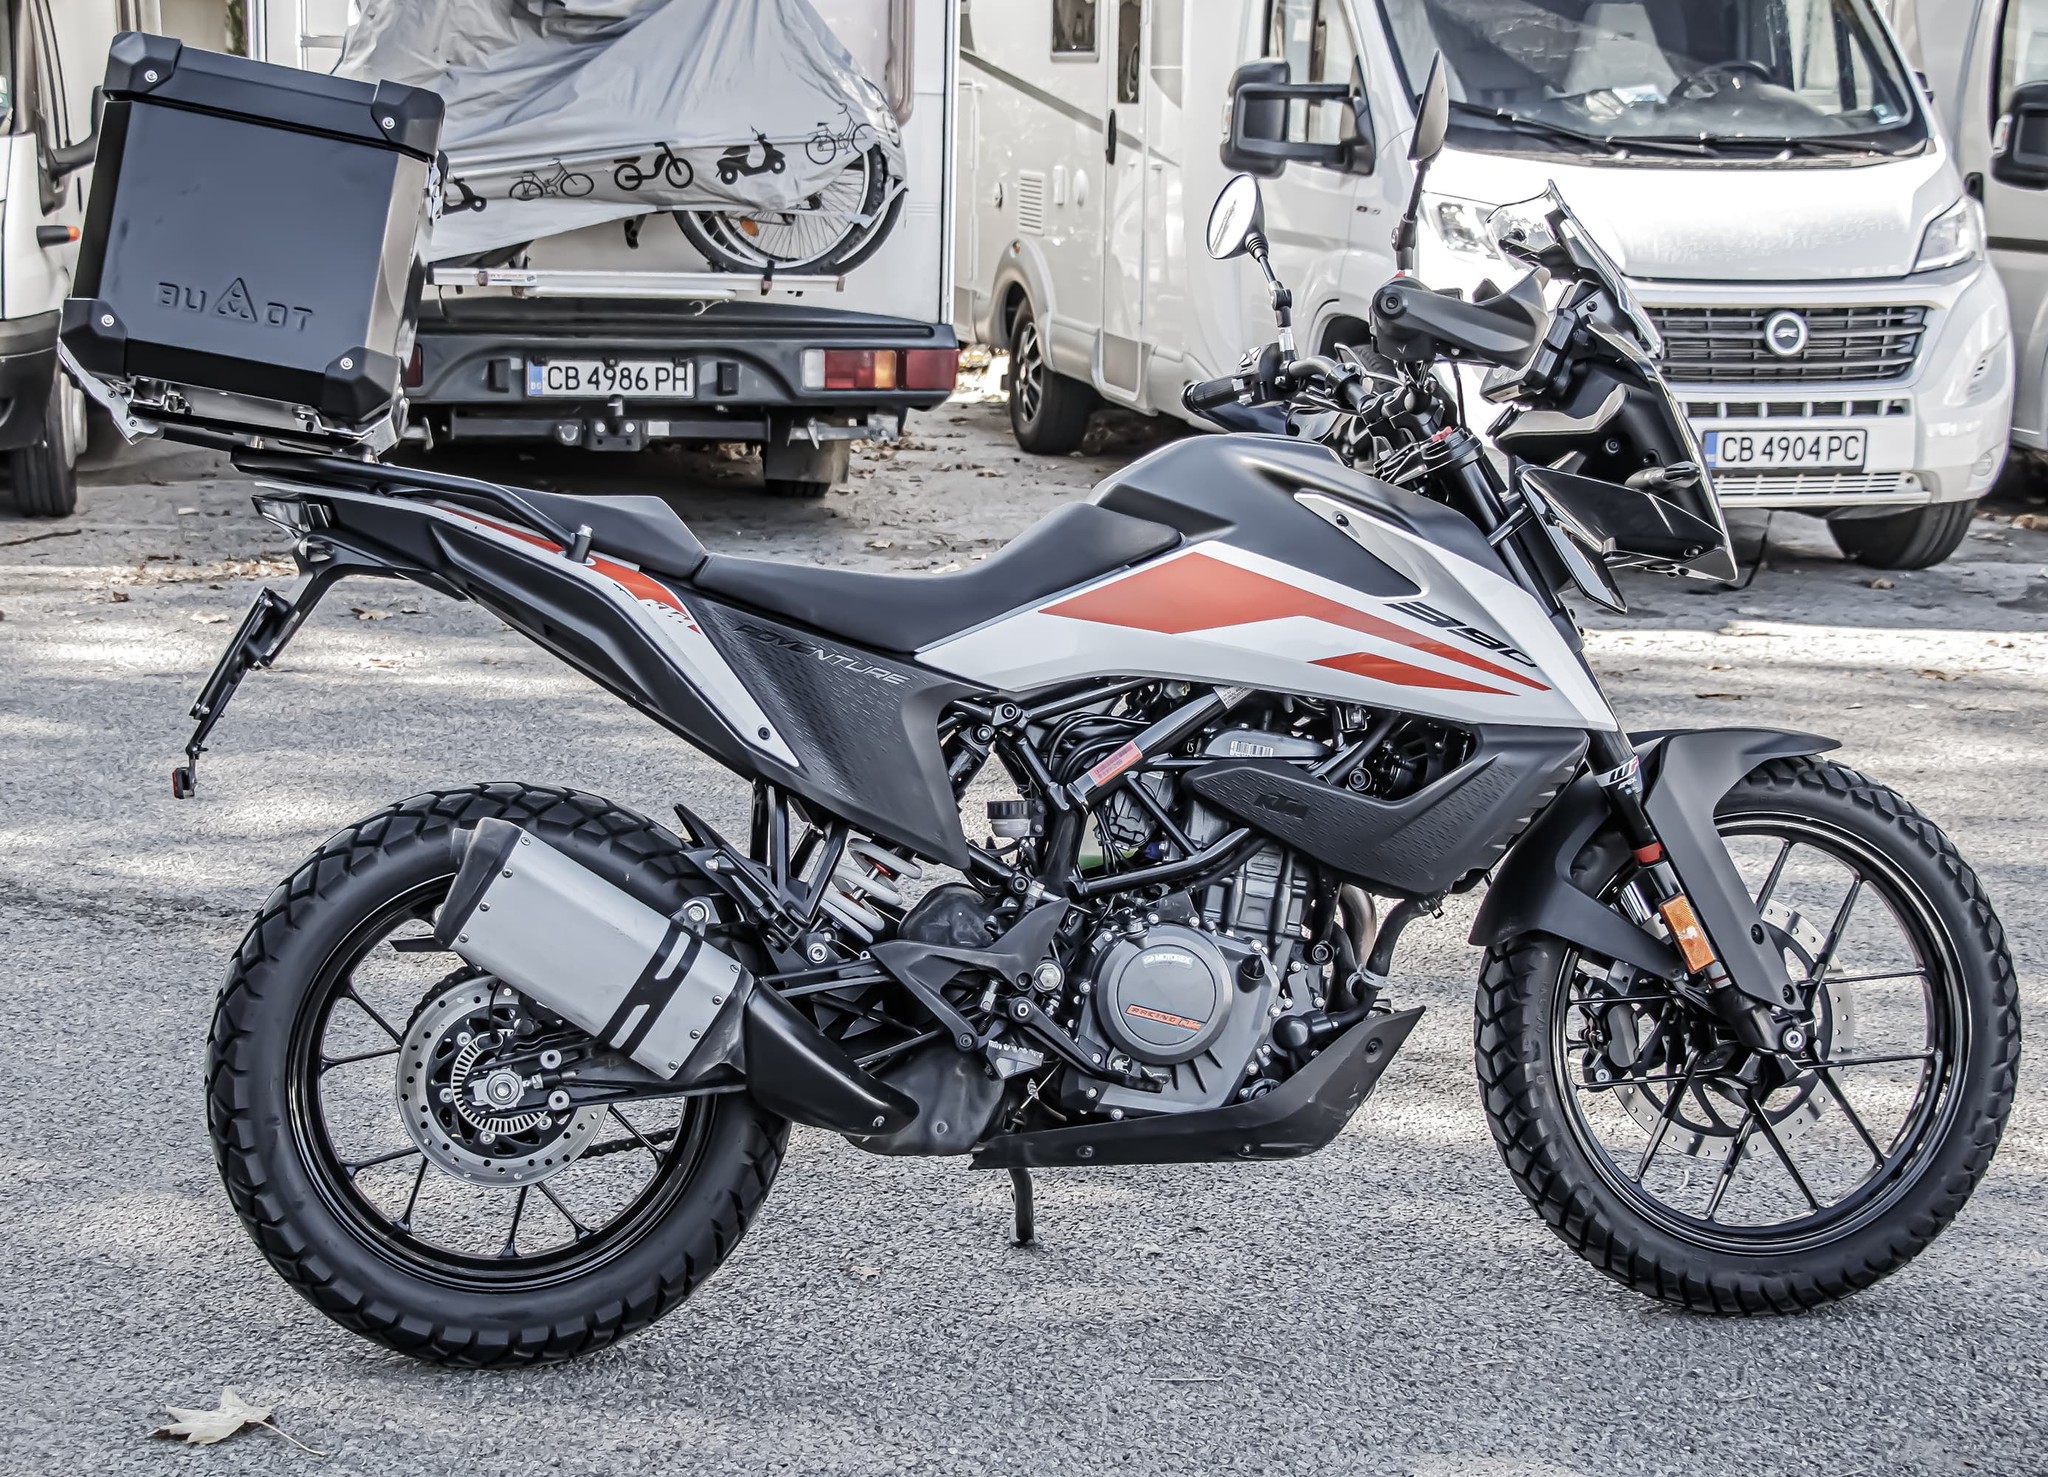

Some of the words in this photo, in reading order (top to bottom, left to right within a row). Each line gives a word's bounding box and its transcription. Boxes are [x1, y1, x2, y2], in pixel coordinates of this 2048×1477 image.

[547, 366, 581, 391] CB
[587, 366, 649, 391] 4986
[655, 366, 688, 391] PH
[1722, 436, 1754, 462] CB
[1760, 436, 1820, 462] 4904
[1827, 435, 1859, 461] PC
[1382, 601, 1538, 668] 390
[733, 624, 910, 685] ADVENTURE
[1253, 794, 1310, 817] KTM
[1154, 953, 1193, 966] MOTOREX
[1131, 1006, 1179, 1024] RACING
